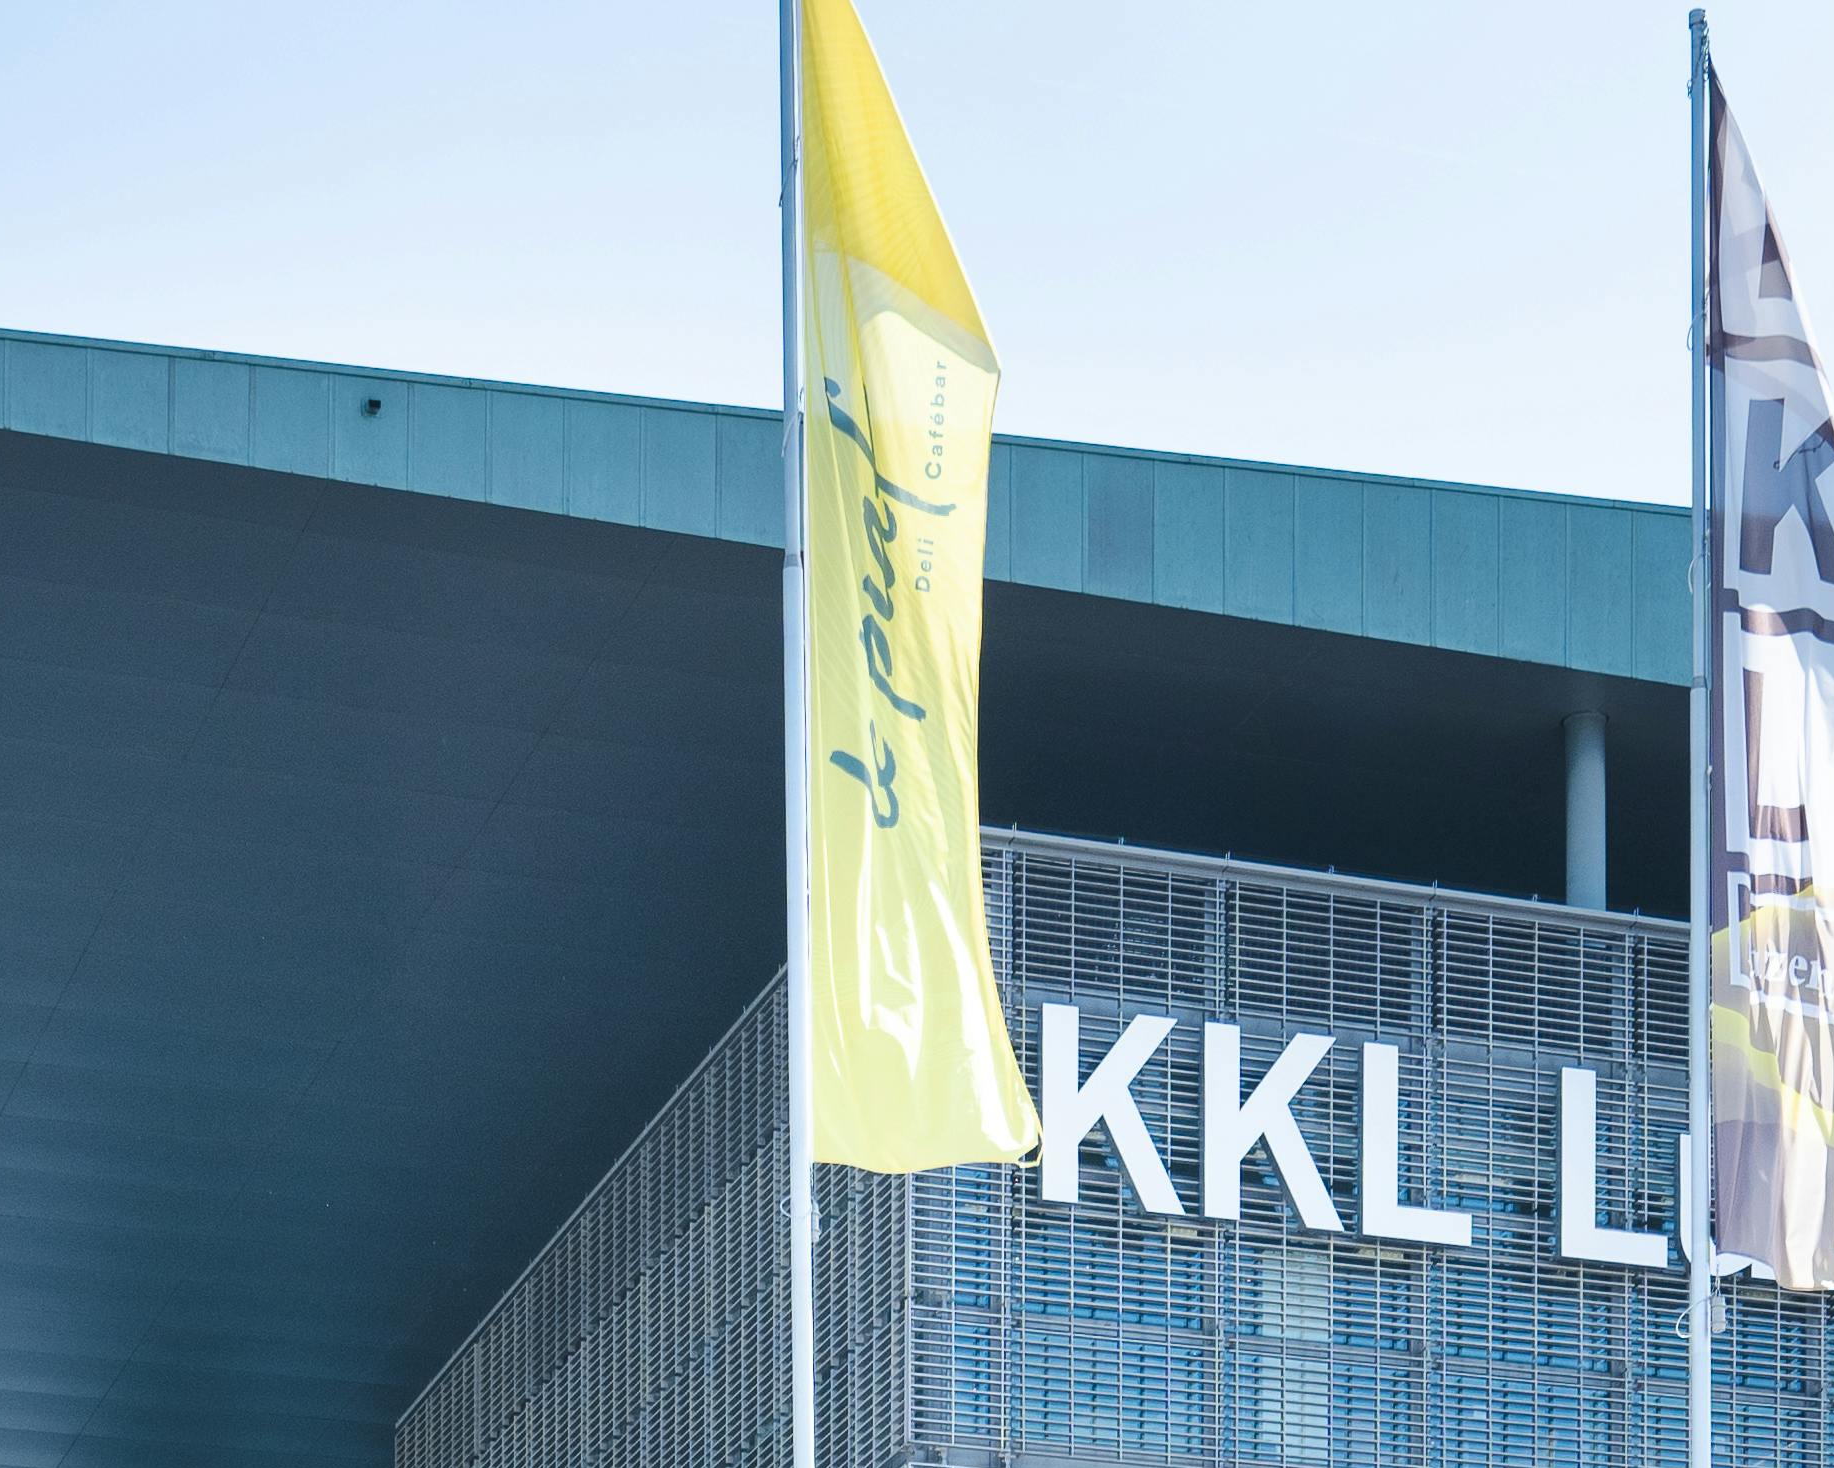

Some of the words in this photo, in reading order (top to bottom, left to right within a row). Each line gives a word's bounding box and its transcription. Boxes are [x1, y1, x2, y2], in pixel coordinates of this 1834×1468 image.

[924, 360, 948, 480] Cafébar
[915, 538, 934, 593] Deli
[1040, 1003, 1472, 1246] KKL
